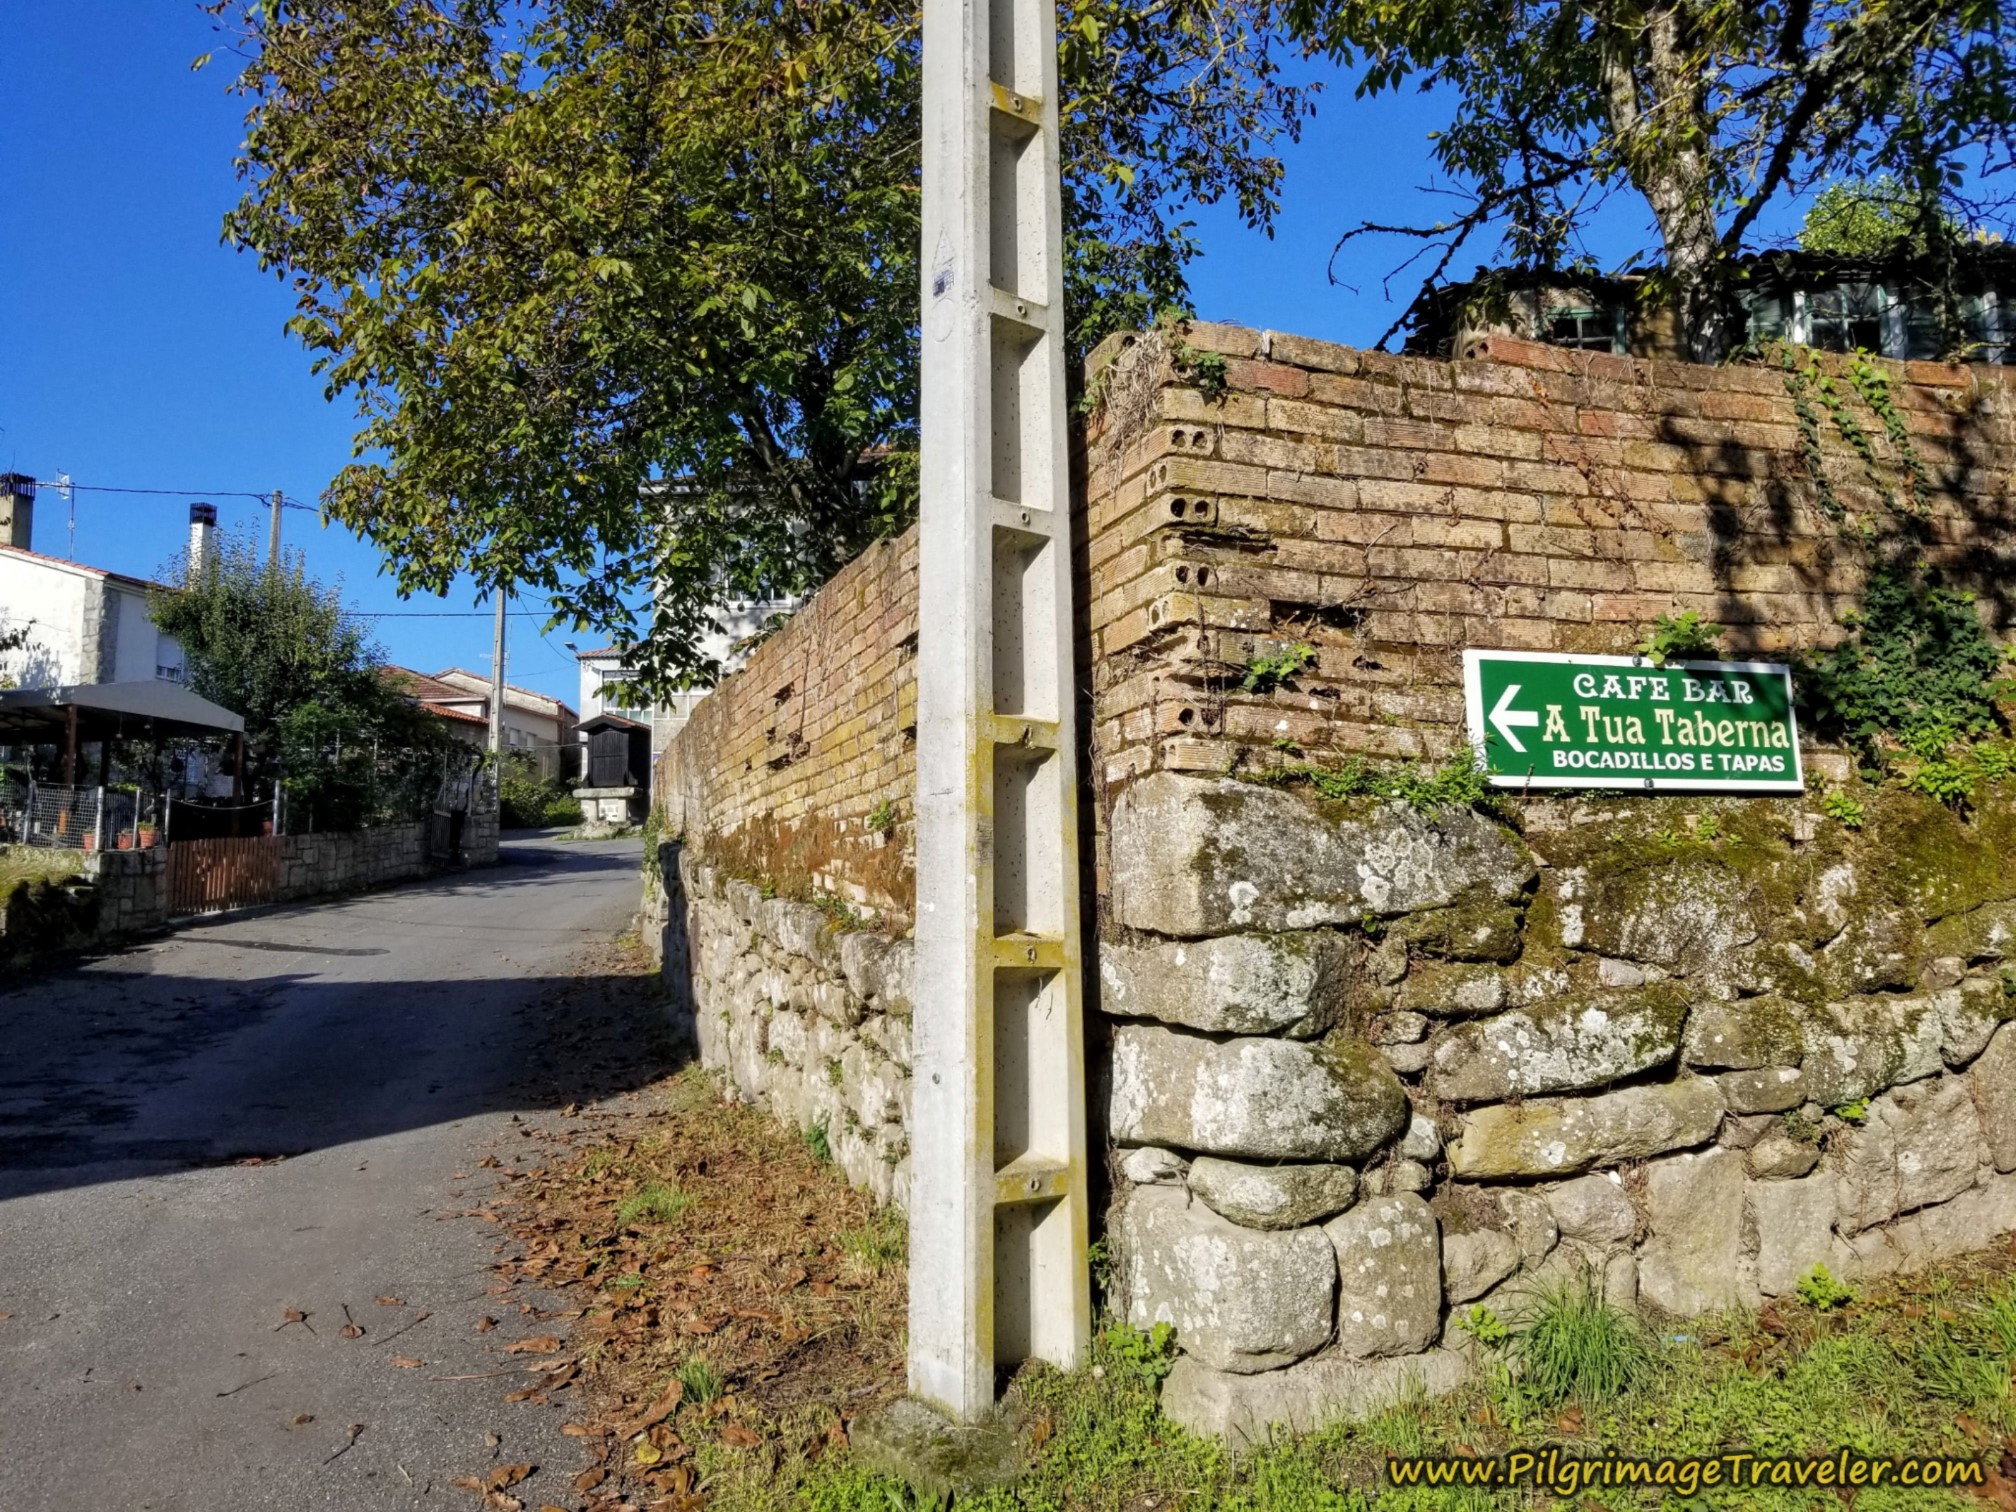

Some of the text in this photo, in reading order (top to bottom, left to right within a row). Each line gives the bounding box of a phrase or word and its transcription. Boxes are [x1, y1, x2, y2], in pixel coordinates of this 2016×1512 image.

[1573, 673, 1754, 705] CAFE BAR
[1542, 704, 1790, 748] A Tua Taberna
[1553, 750, 1785, 772] BOCADILLOS E TAPAS
